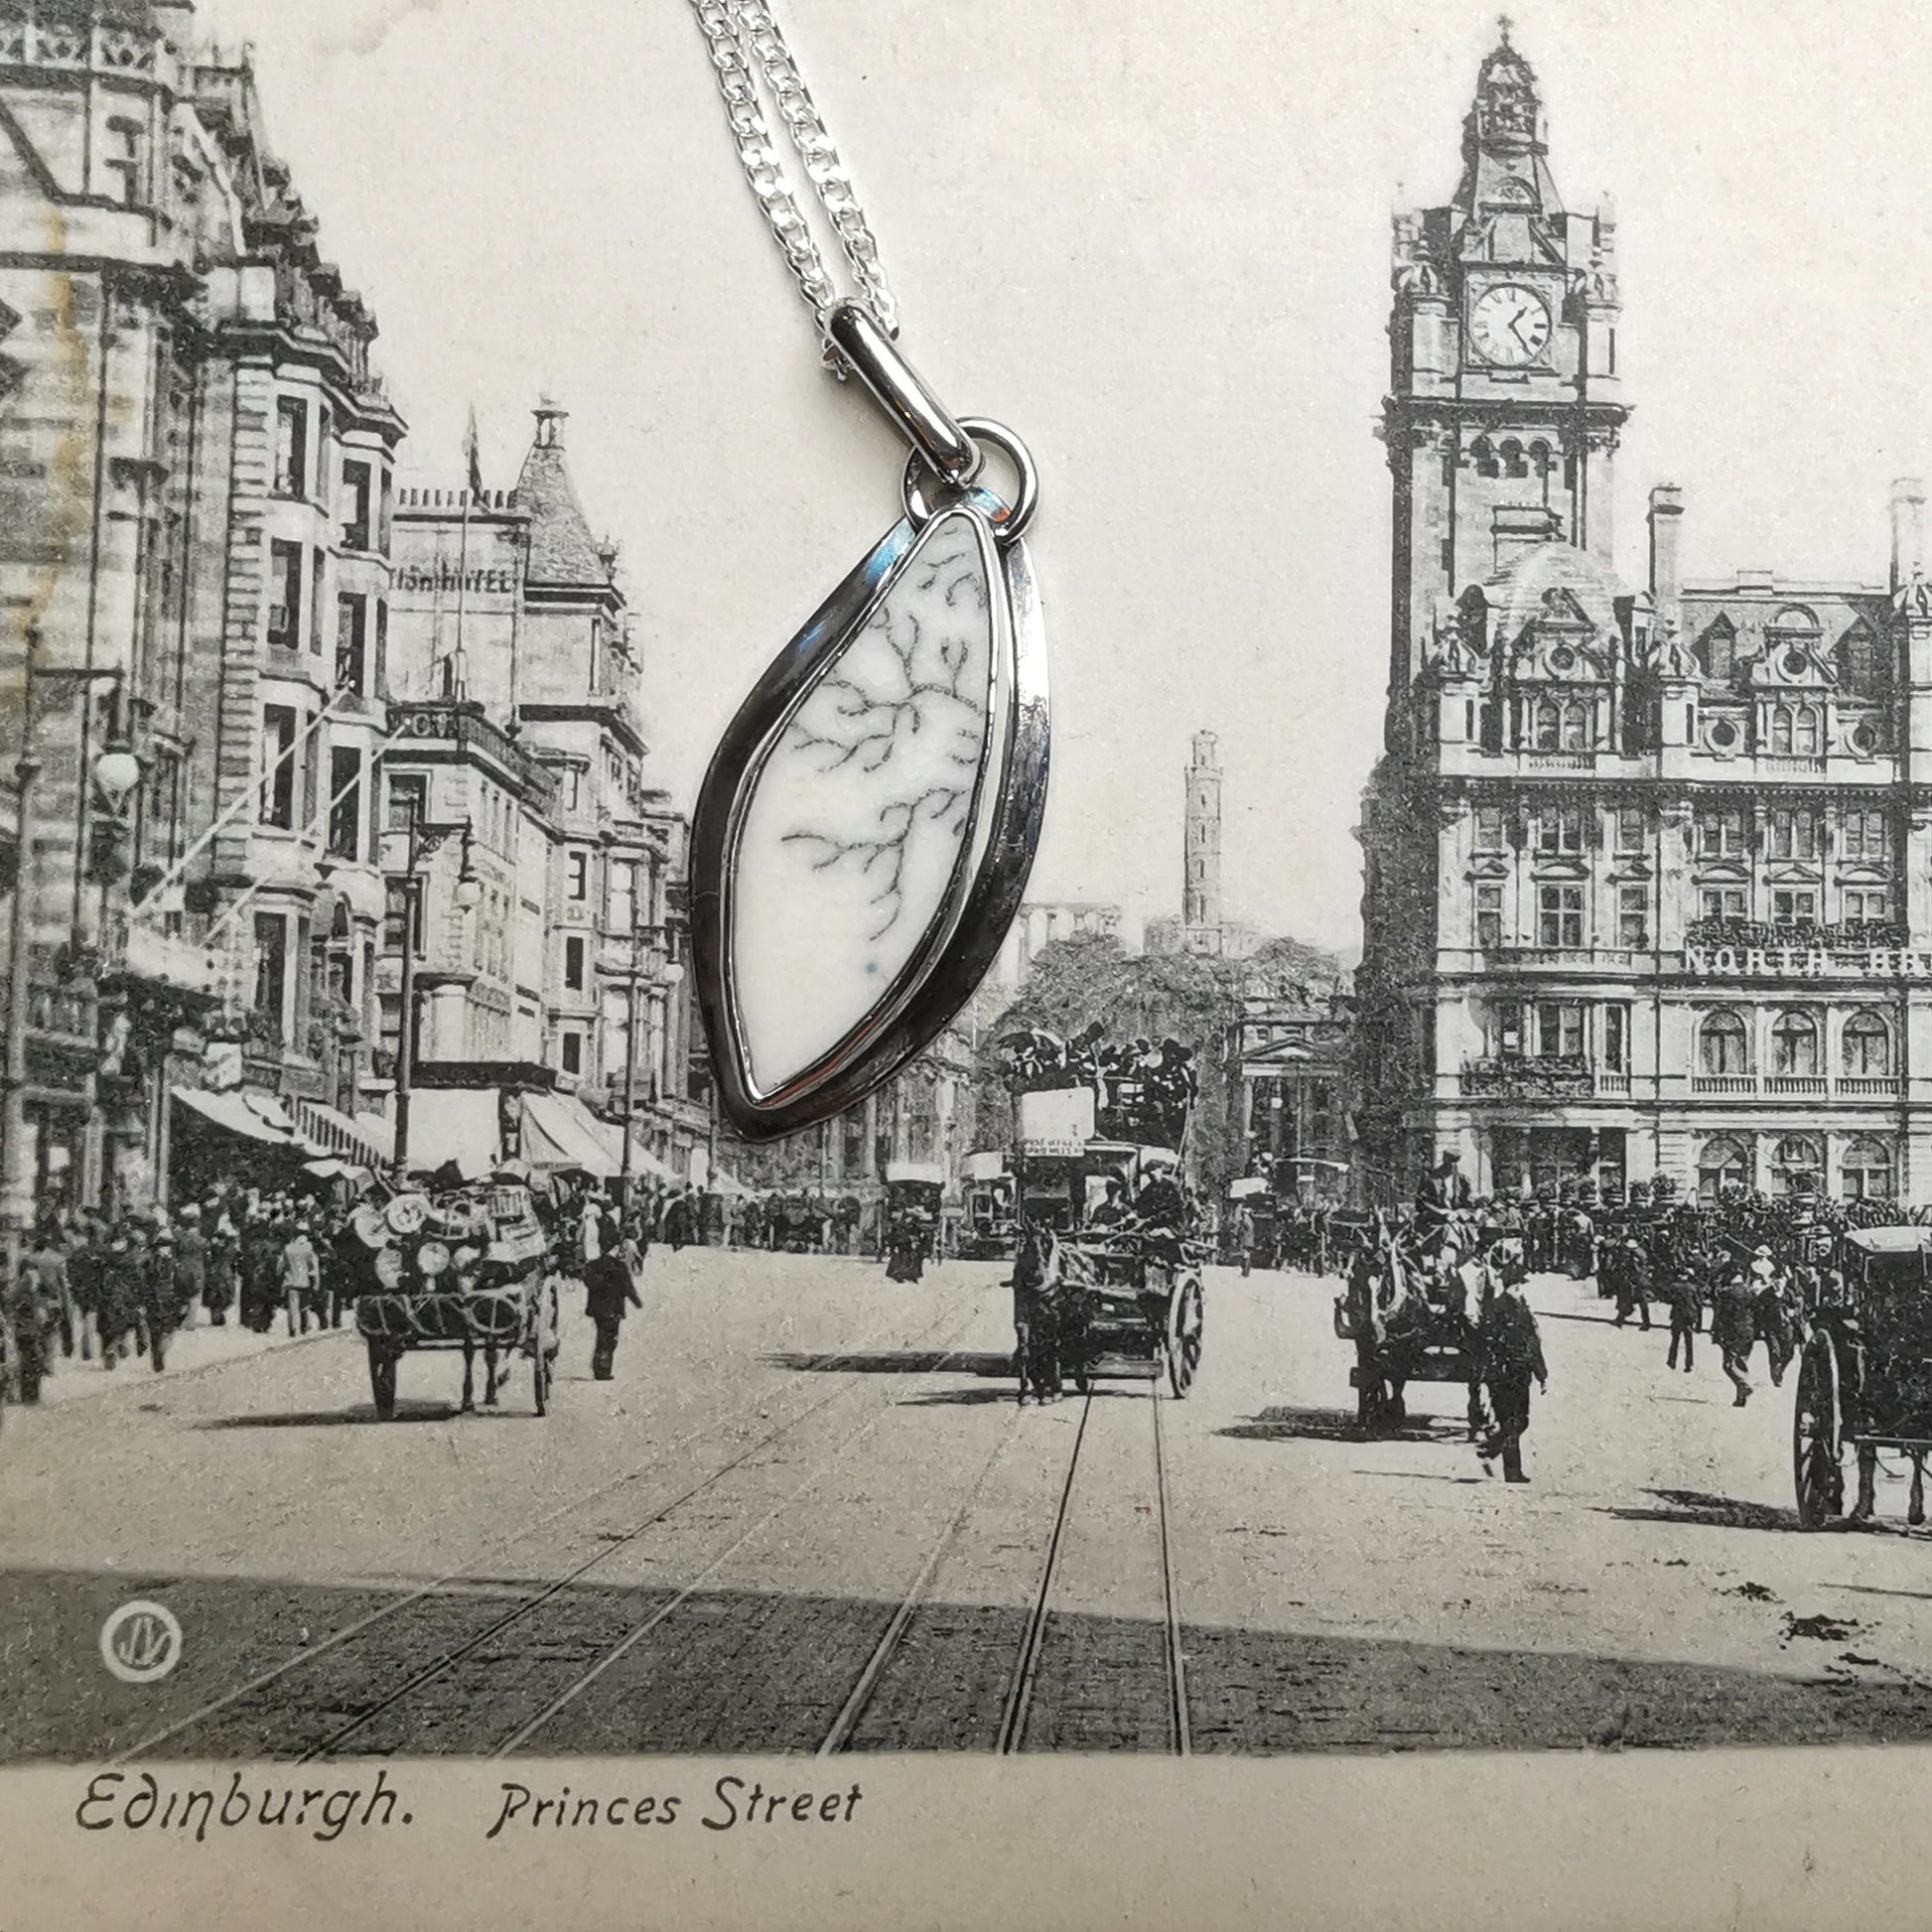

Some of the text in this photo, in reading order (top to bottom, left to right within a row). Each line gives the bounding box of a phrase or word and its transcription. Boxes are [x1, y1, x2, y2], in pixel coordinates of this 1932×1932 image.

[1685, 946, 1829, 977] NORTH
[75, 1770, 863, 1843] Edinburgh. Princes Street
